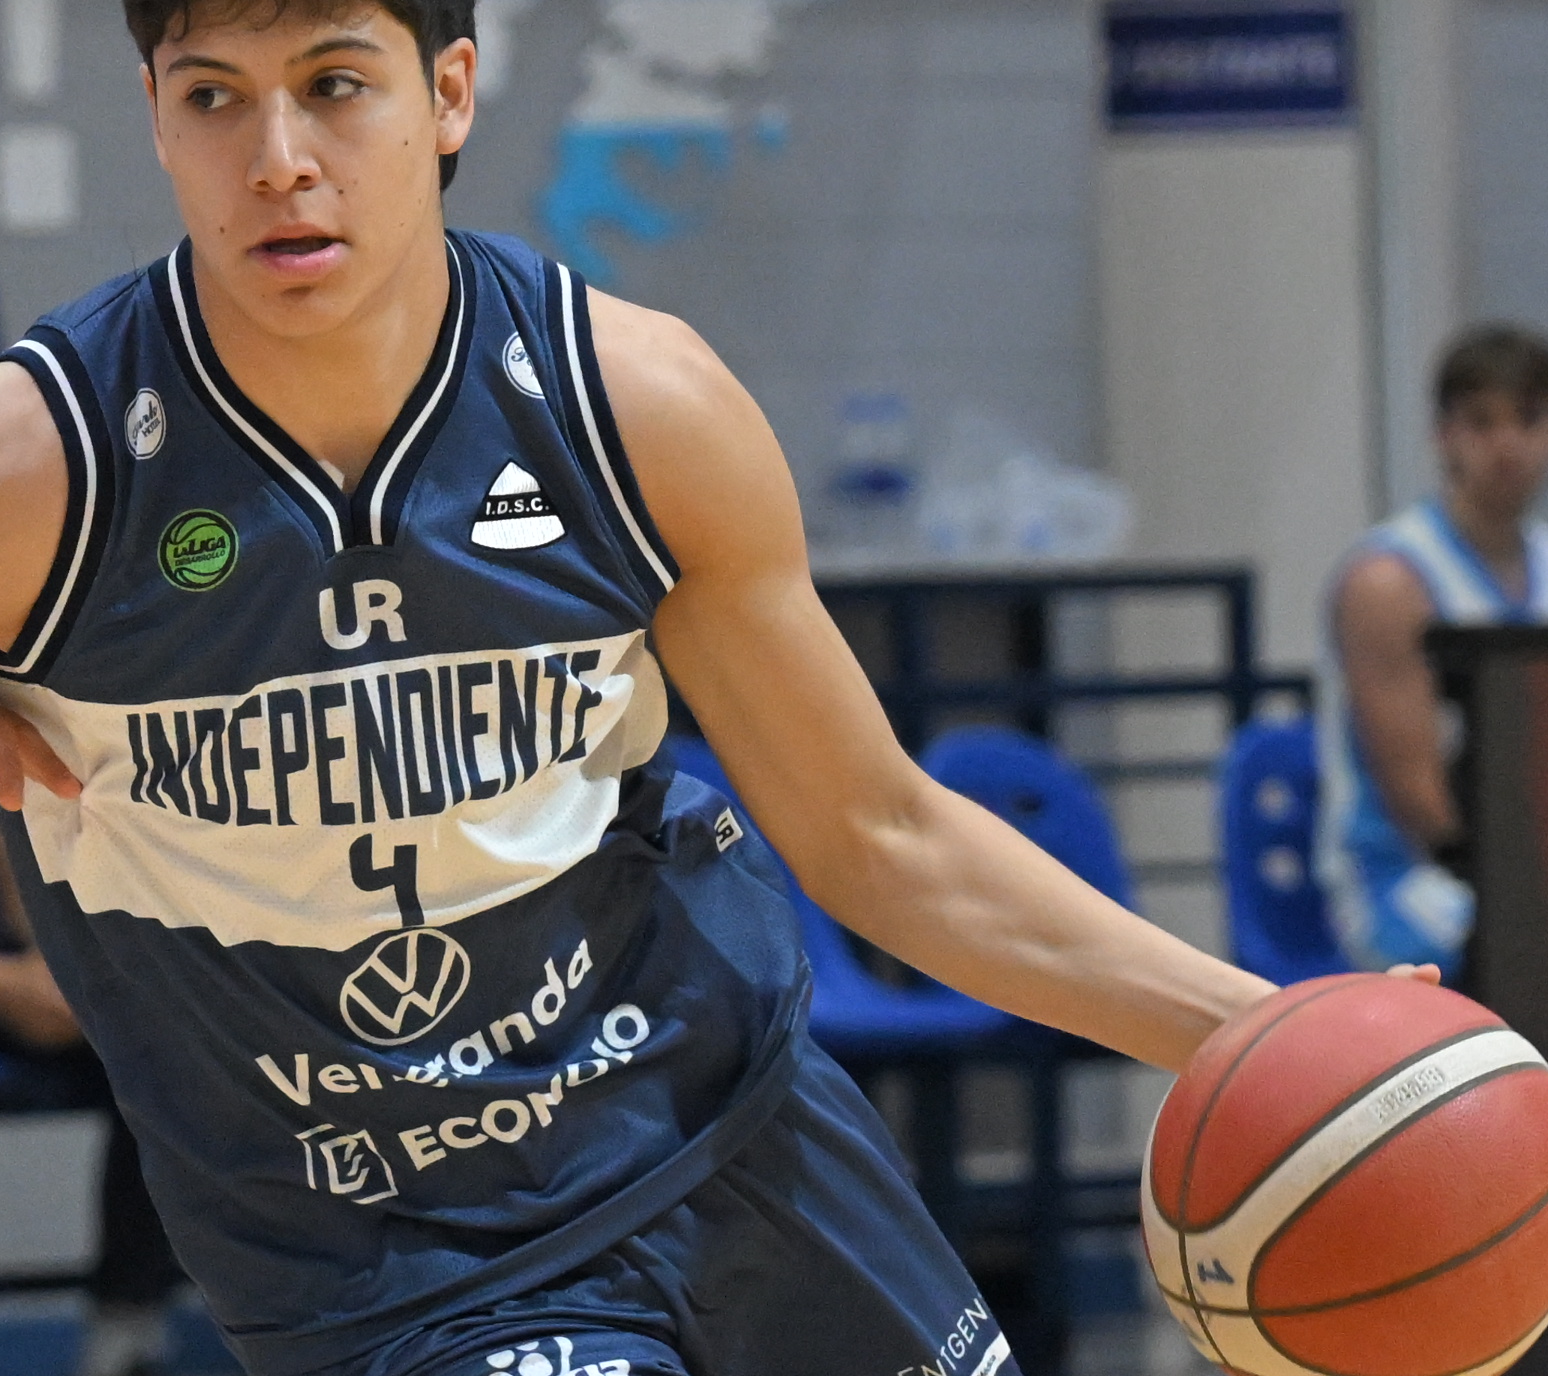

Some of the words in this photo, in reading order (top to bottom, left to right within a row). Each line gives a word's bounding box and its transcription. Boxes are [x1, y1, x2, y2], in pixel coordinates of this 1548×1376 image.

[485, 496, 550, 516] I.D.S.C.
[318, 579, 407, 650] UR
[126, 649, 602, 827] INDEPENDIENTE
[349, 833, 425, 927] 4
